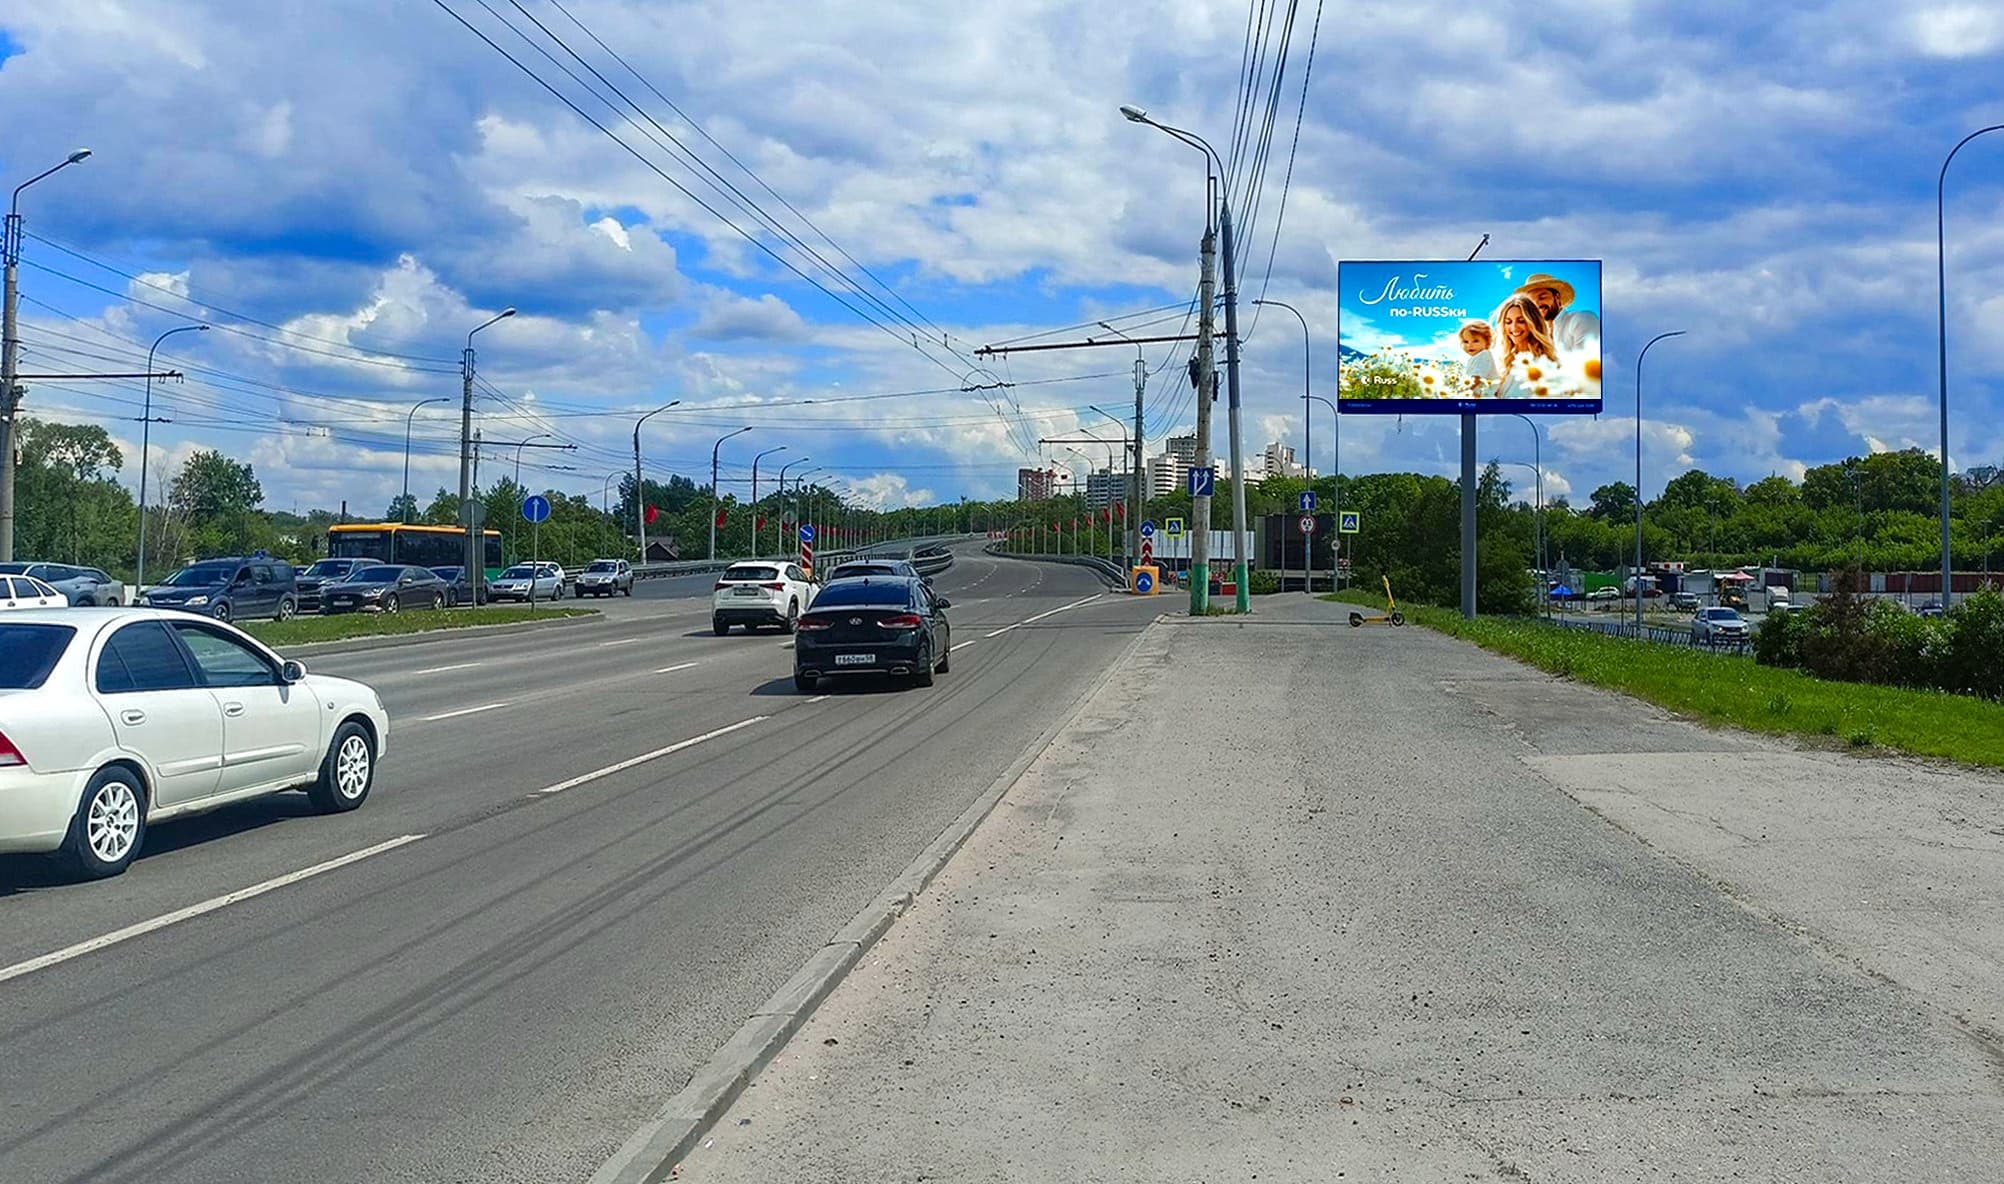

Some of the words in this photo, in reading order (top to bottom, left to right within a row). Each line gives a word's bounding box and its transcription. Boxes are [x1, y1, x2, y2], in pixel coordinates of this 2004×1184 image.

[1359, 273, 1455, 305] Любить
[1389, 305, 1467, 318] по-RUSSки
[1373, 375, 1398, 385] Russ
